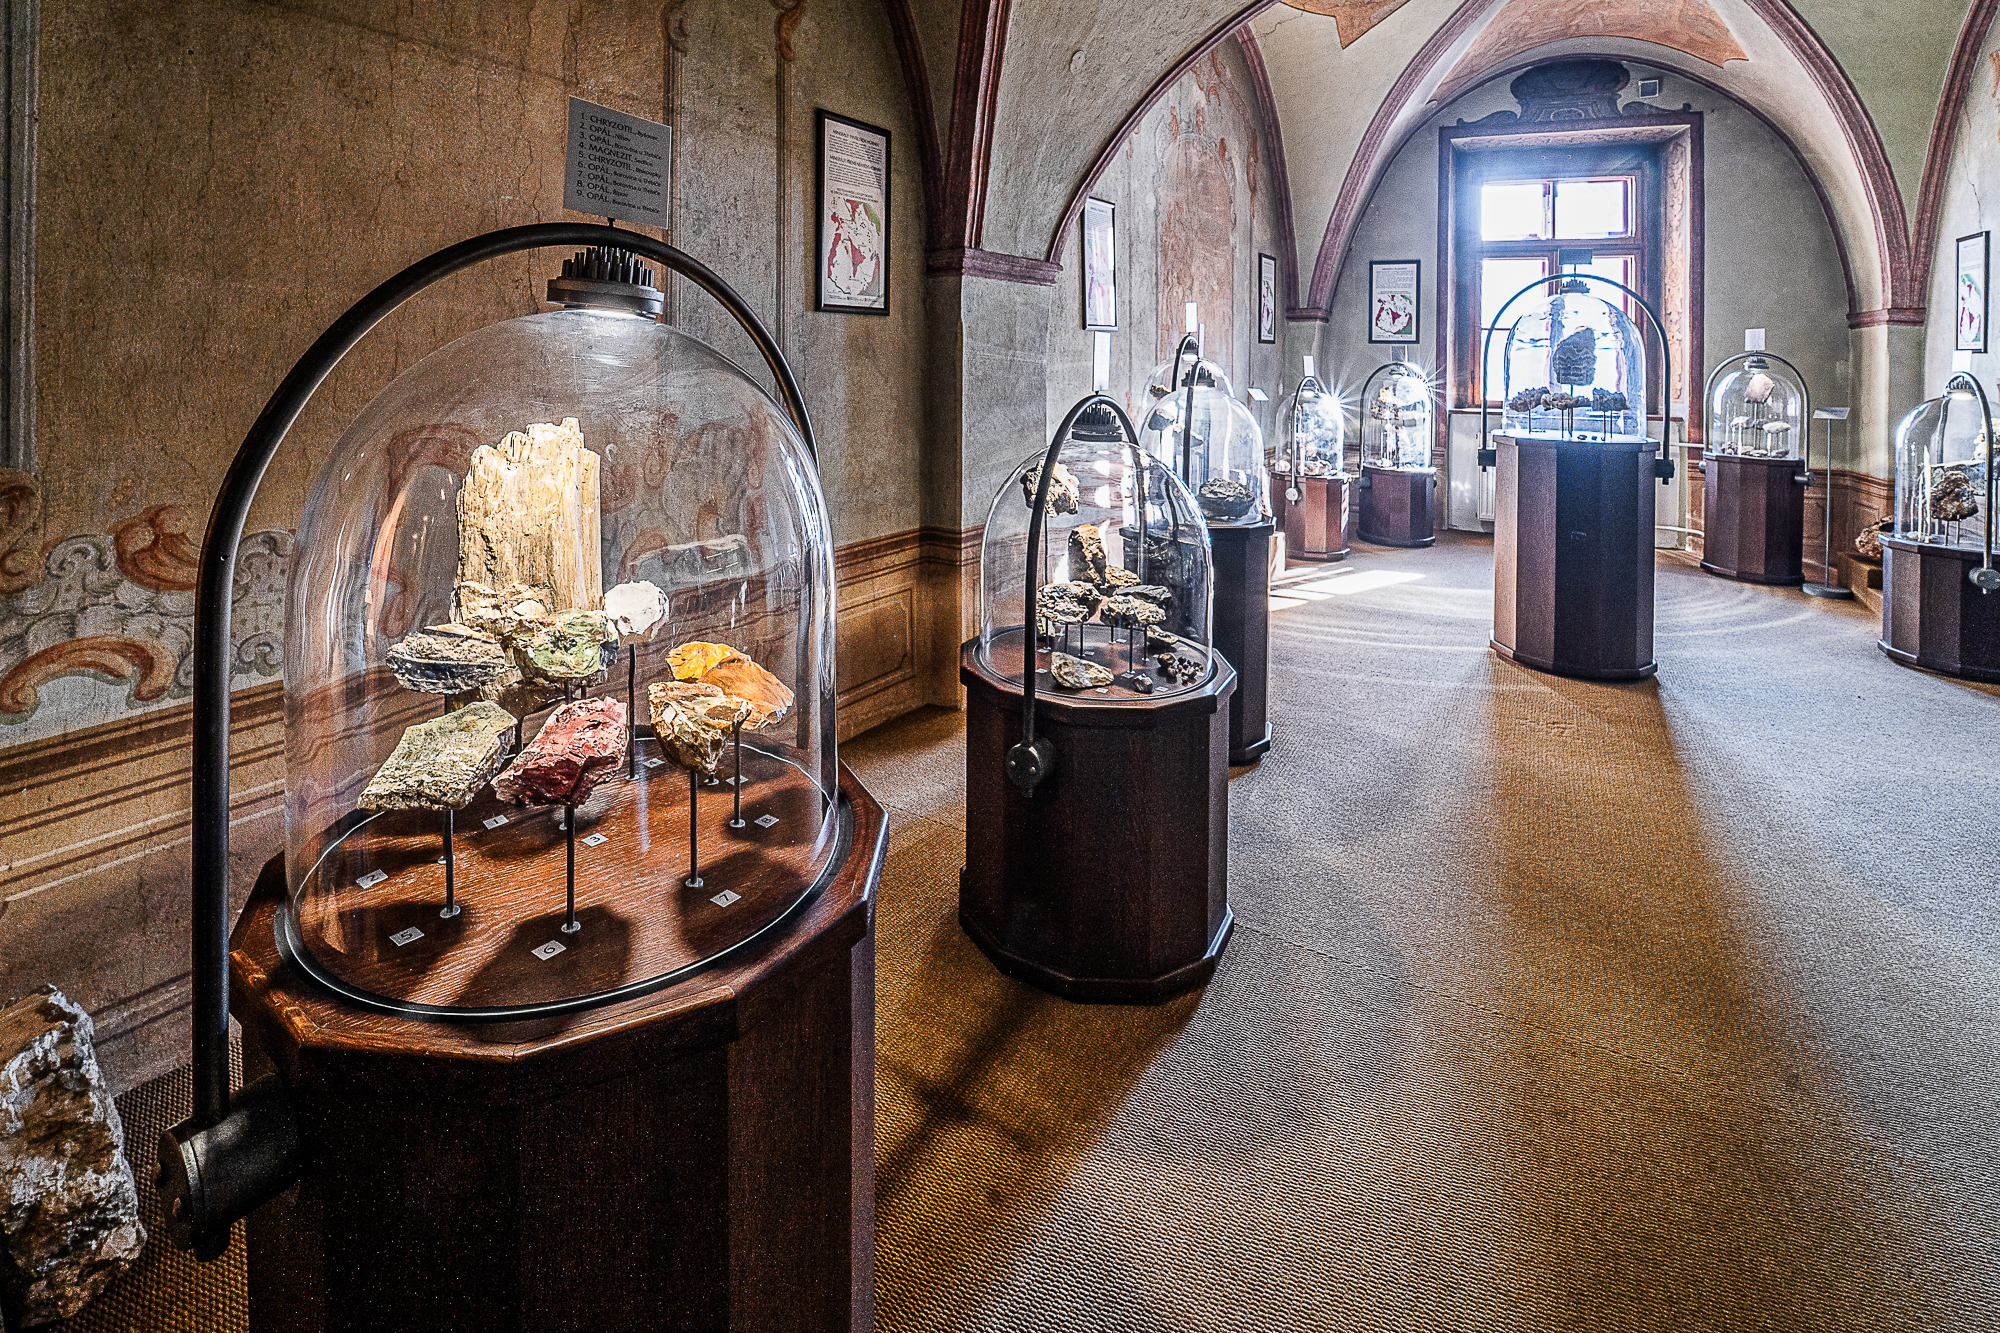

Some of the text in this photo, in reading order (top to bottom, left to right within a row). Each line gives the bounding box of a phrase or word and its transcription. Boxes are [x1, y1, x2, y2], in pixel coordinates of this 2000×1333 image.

[579, 131, 587, 139] 3.
[577, 160, 586, 169] 6.
[577, 180, 585, 188] 8.
[576, 190, 584, 198] 9.
[366, 874, 379, 882] 2
[718, 893, 729, 902] 7
[400, 929, 413, 940] 5
[543, 944, 556, 954] 6
